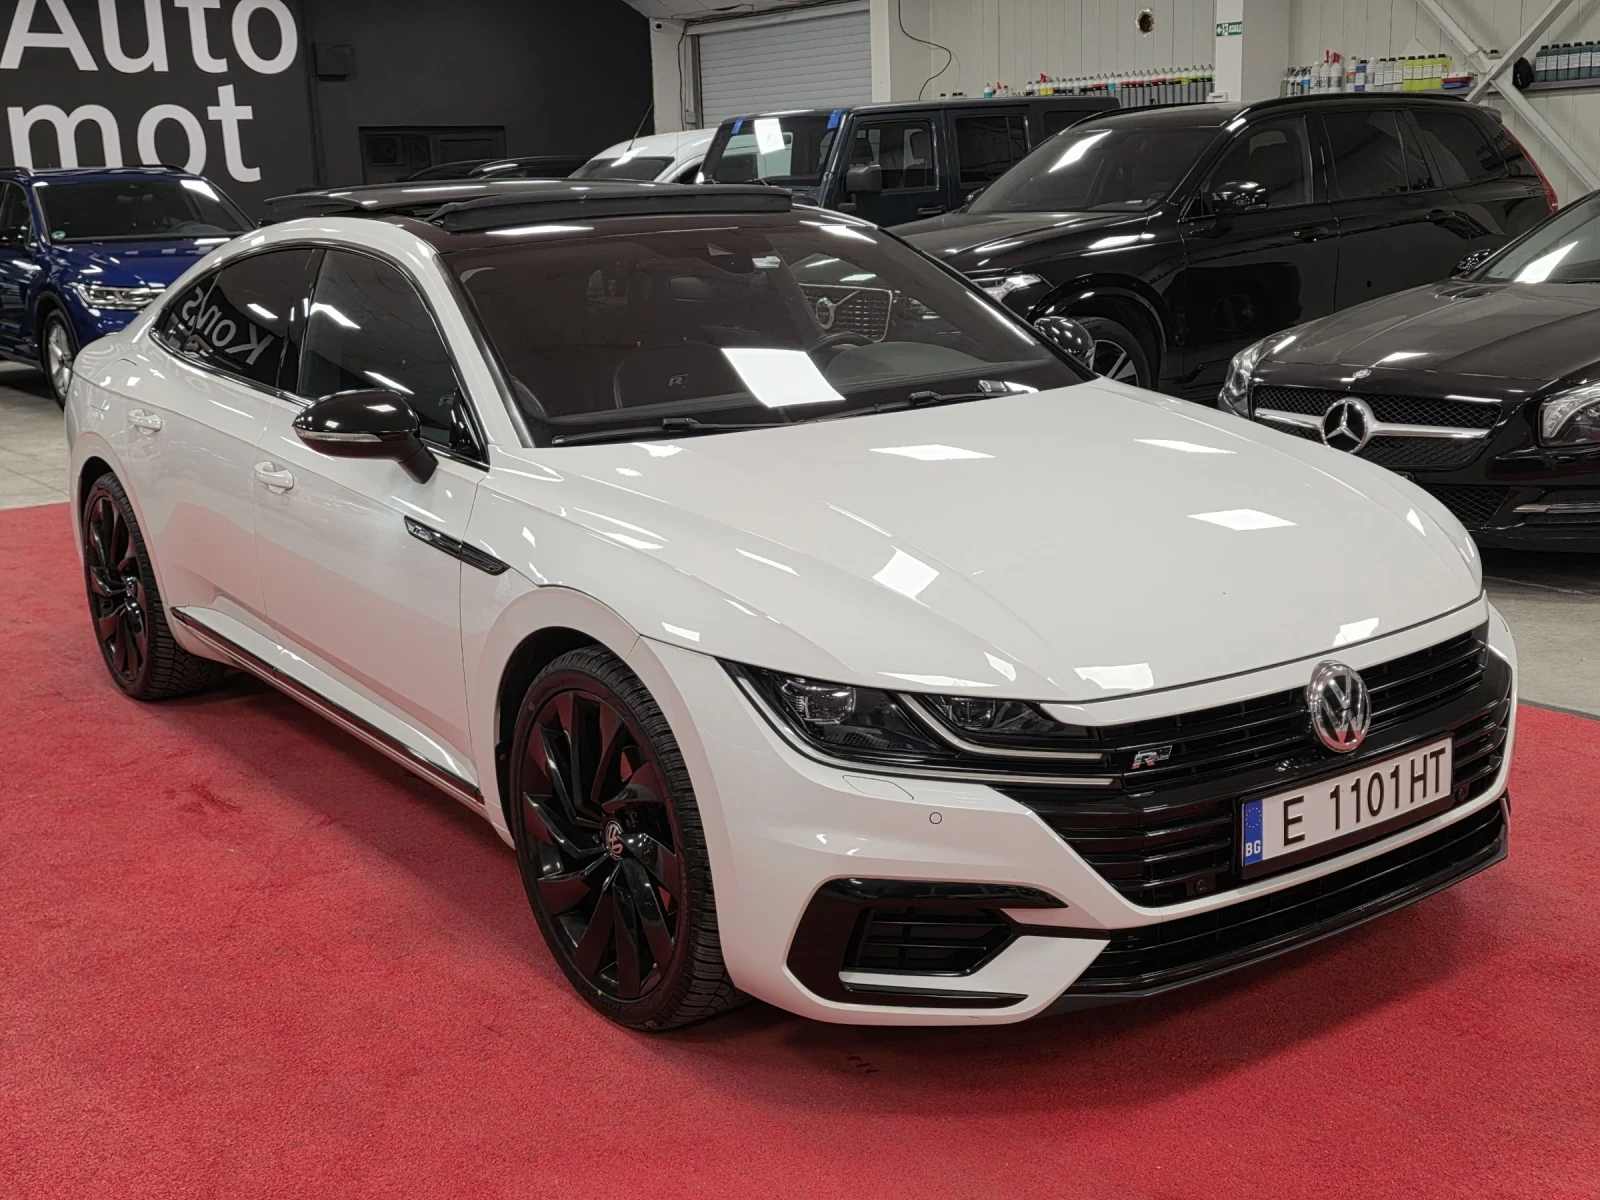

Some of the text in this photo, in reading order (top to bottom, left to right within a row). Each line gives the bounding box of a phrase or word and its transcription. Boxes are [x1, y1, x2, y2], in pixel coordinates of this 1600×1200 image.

[0, 0, 298, 74] Auto
[7, 84, 261, 182] mot
[1245, 840, 1261, 857] BG
[1283, 795, 1305, 847] E
